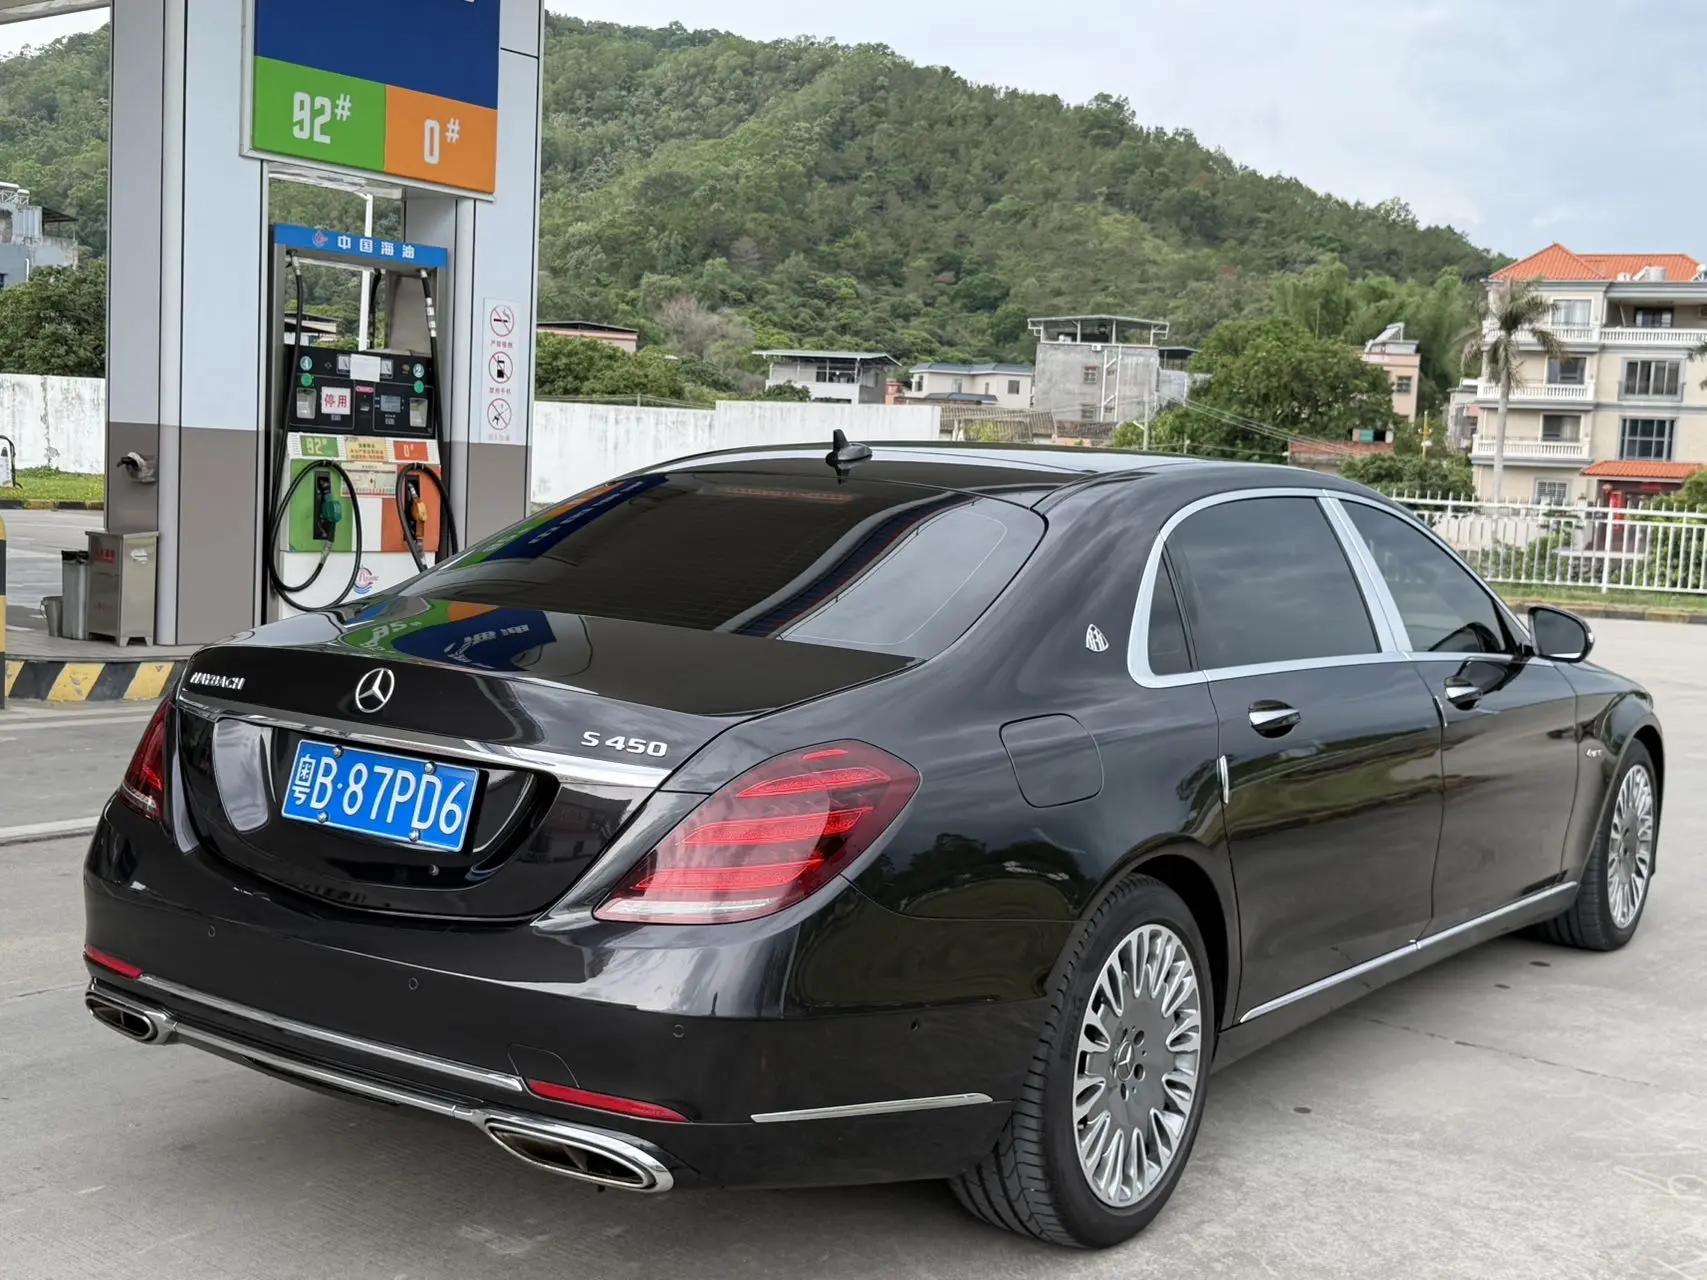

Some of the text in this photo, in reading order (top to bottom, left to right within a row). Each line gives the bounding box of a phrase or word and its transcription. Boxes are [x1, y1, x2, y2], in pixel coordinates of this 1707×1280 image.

[292, 91, 352, 144] 92#
[424, 117, 460, 164] 0#
[337, 234, 415, 259] 中国海油
[325, 393, 347, 408] 停用
[581, 731, 668, 757] S 450
